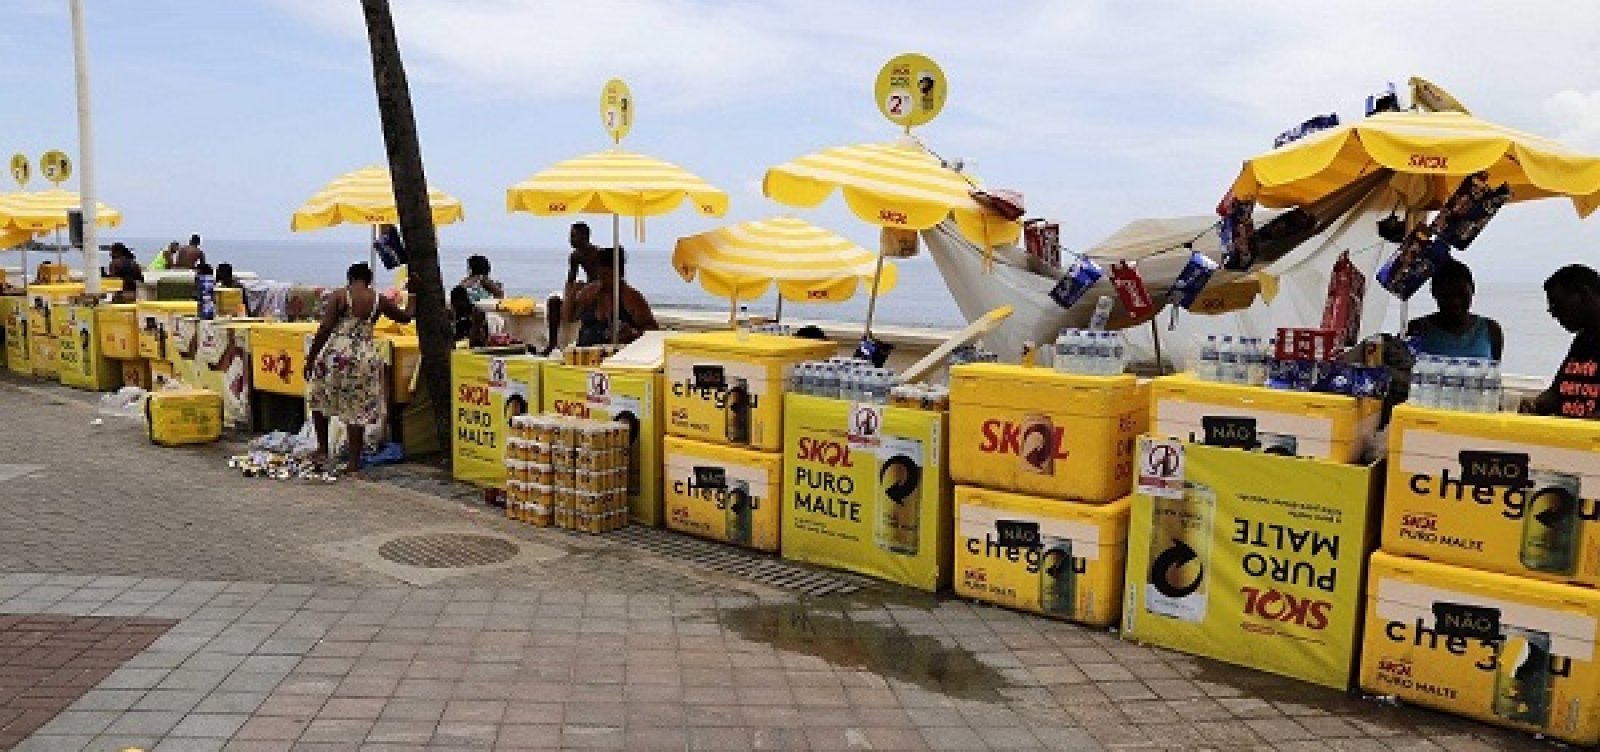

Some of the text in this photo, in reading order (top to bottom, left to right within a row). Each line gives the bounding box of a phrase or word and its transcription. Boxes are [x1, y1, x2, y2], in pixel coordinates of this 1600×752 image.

[459, 384, 491, 406] SKOL
[1213, 424, 1250, 441] NÃO
[798, 437, 854, 467] SKOL
[795, 467, 854, 496] PURO
[1471, 458, 1519, 478] NÃO
[795, 491, 861, 523] MALTE
[1232, 517, 1340, 561] MALTE
[1242, 552, 1337, 592] PURO
[1240, 586, 1333, 630] SKOL
[1444, 611, 1492, 632] NÃO
